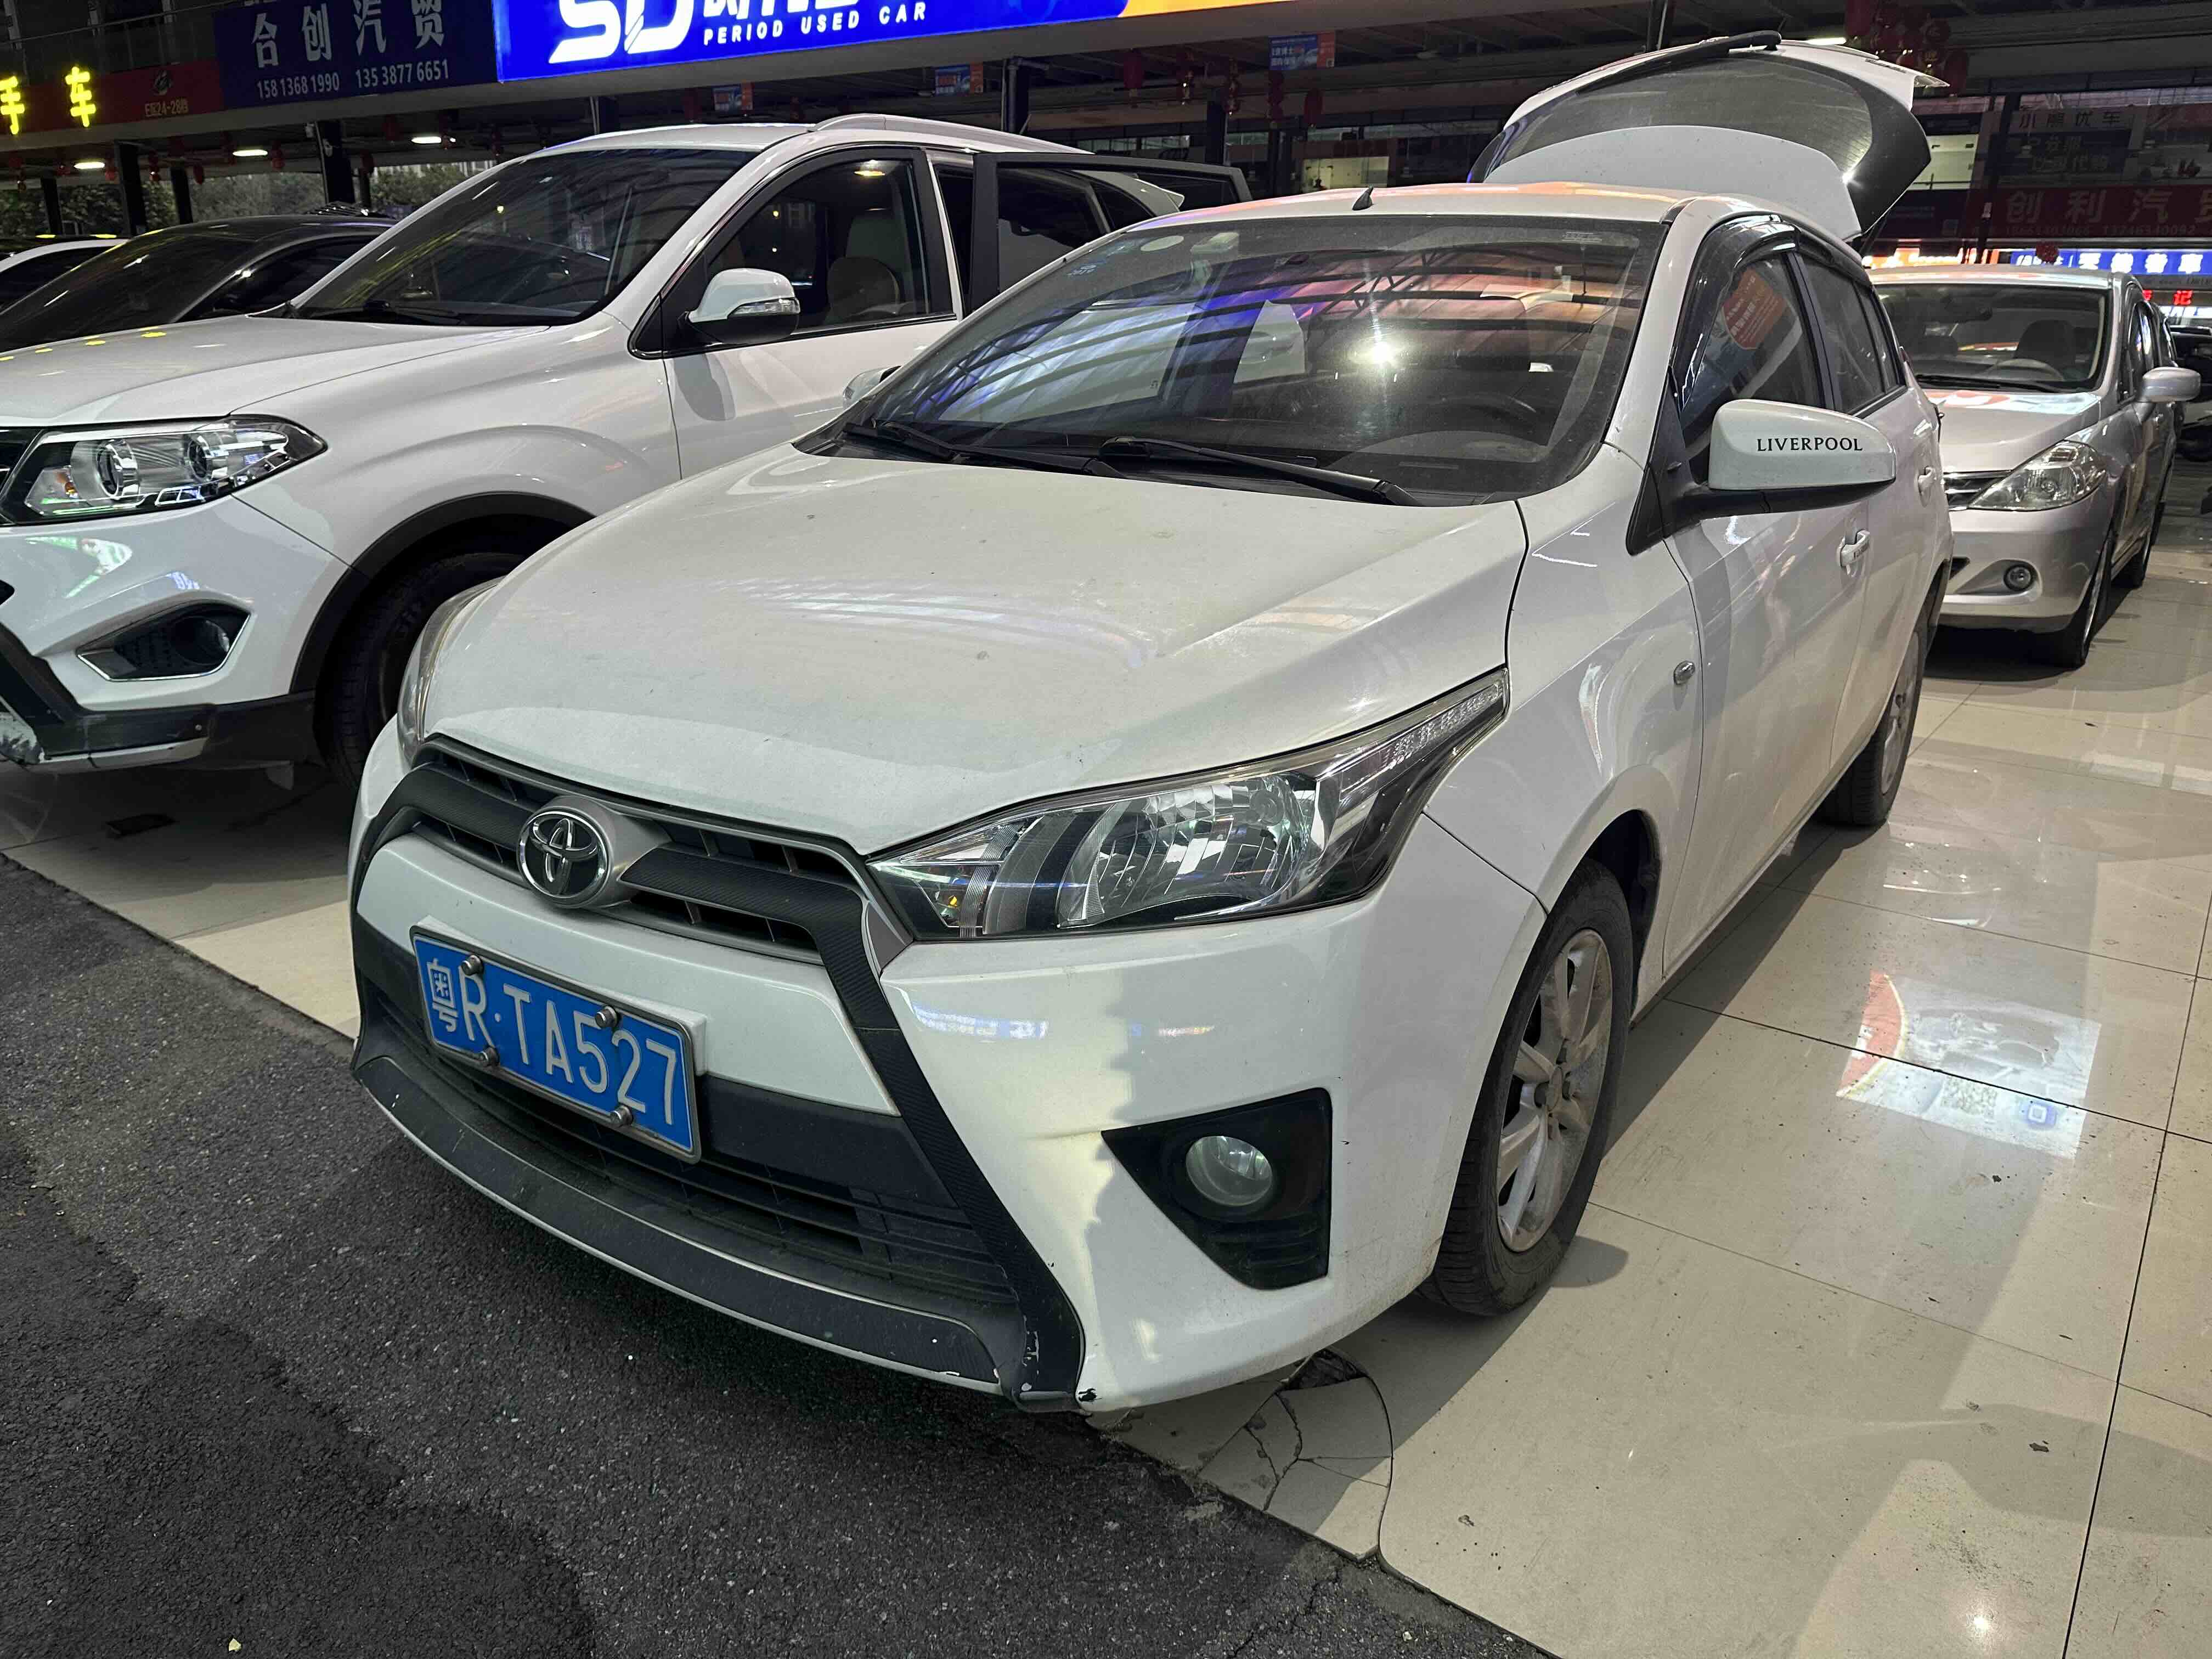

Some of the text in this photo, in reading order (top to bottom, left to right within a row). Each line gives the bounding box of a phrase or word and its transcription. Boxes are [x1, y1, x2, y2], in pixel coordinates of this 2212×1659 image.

[251, 0, 445, 69] 合创汽贸
[704, 20, 783, 46] PERIOD
[800, 10, 860, 35] USED
[879, 1, 927, 25] CAR
[256, 59, 449, 99] 158 1368 1990 135 3877 6651
[1757, 437, 1863, 452] LIVERPOOL
